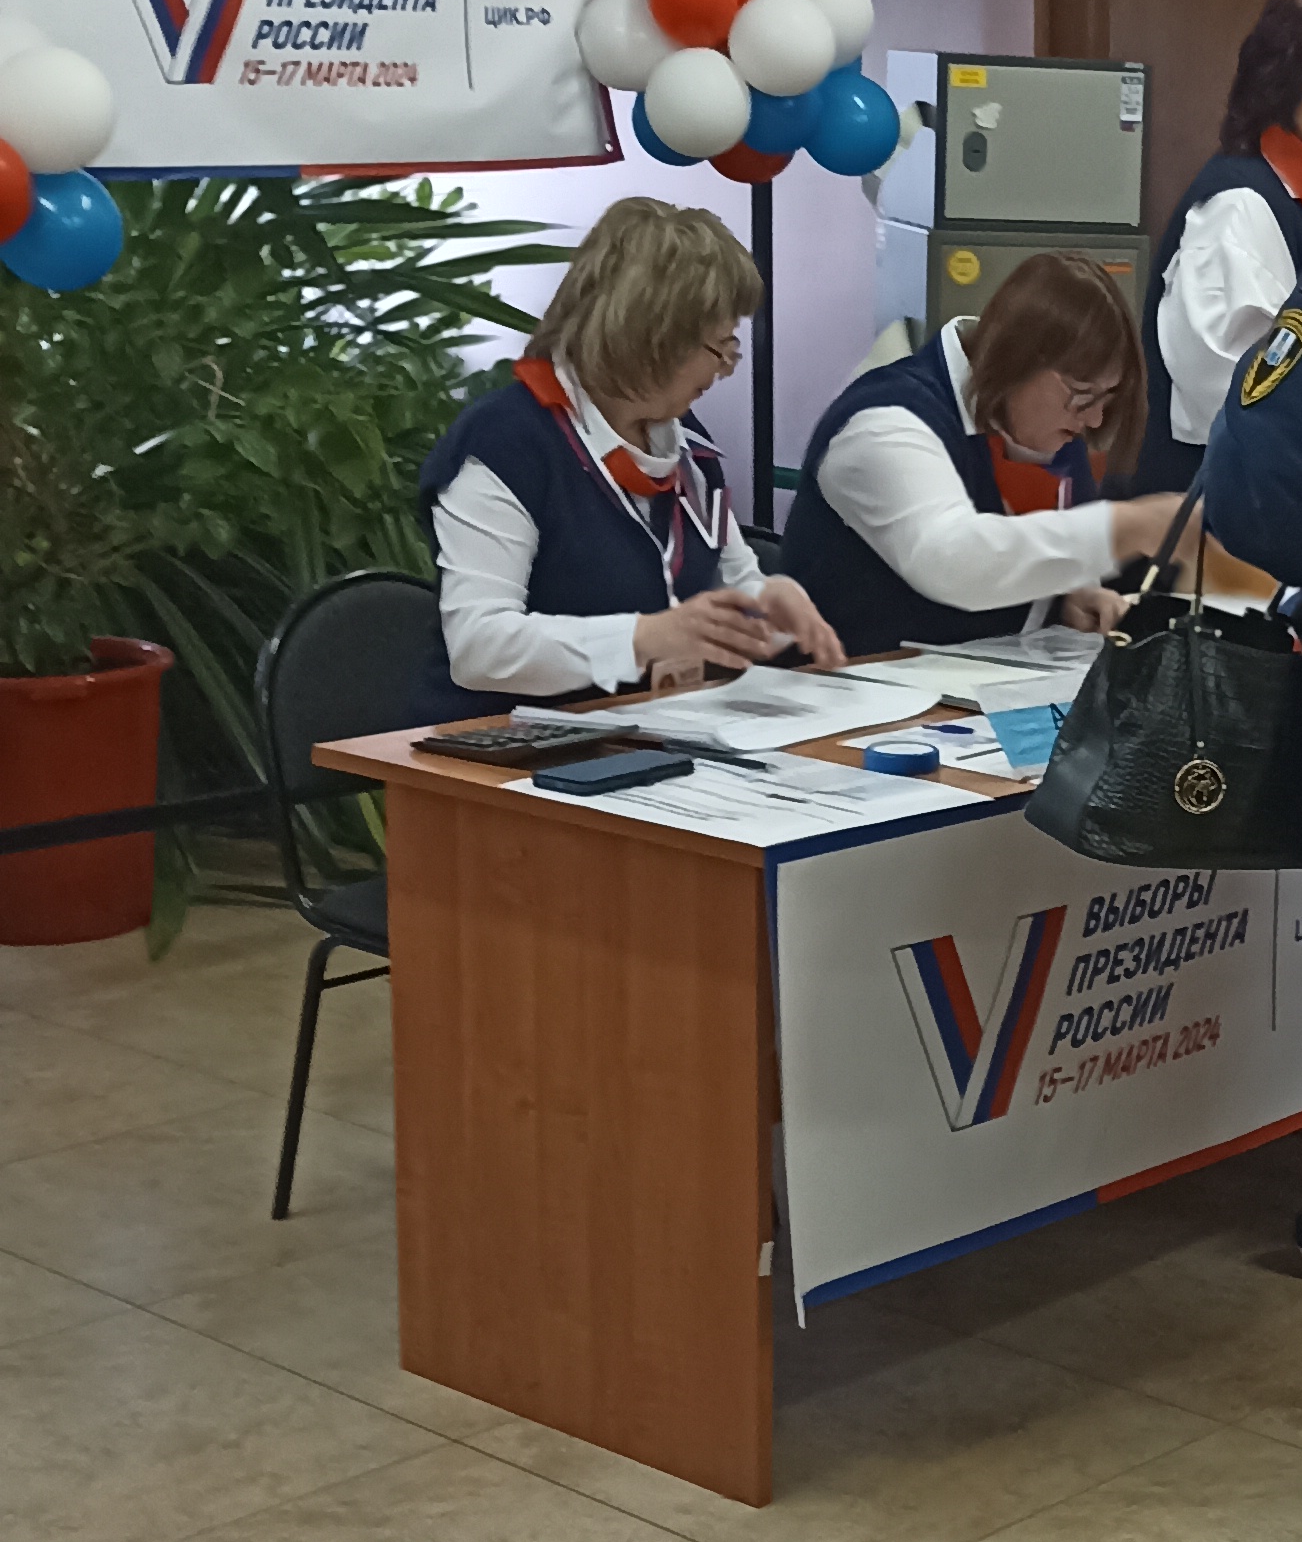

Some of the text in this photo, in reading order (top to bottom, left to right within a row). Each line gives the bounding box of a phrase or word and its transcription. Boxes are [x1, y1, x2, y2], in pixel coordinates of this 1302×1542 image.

[251, 19, 369, 51] РОССИИ
[483, 5, 552, 28] ЦИК.РФ
[301, 61, 369, 87] МАРТА
[372, 62, 417, 87] 2024
[1083, 870, 1217, 938] ВЫБОРЫ
[1066, 908, 1249, 996] ПРЕЗИДЕНТА
[1048, 982, 1174, 1056] РОССИИ
[1099, 1031, 1170, 1085] МАРТА
[1171, 1014, 1221, 1060] 2024
